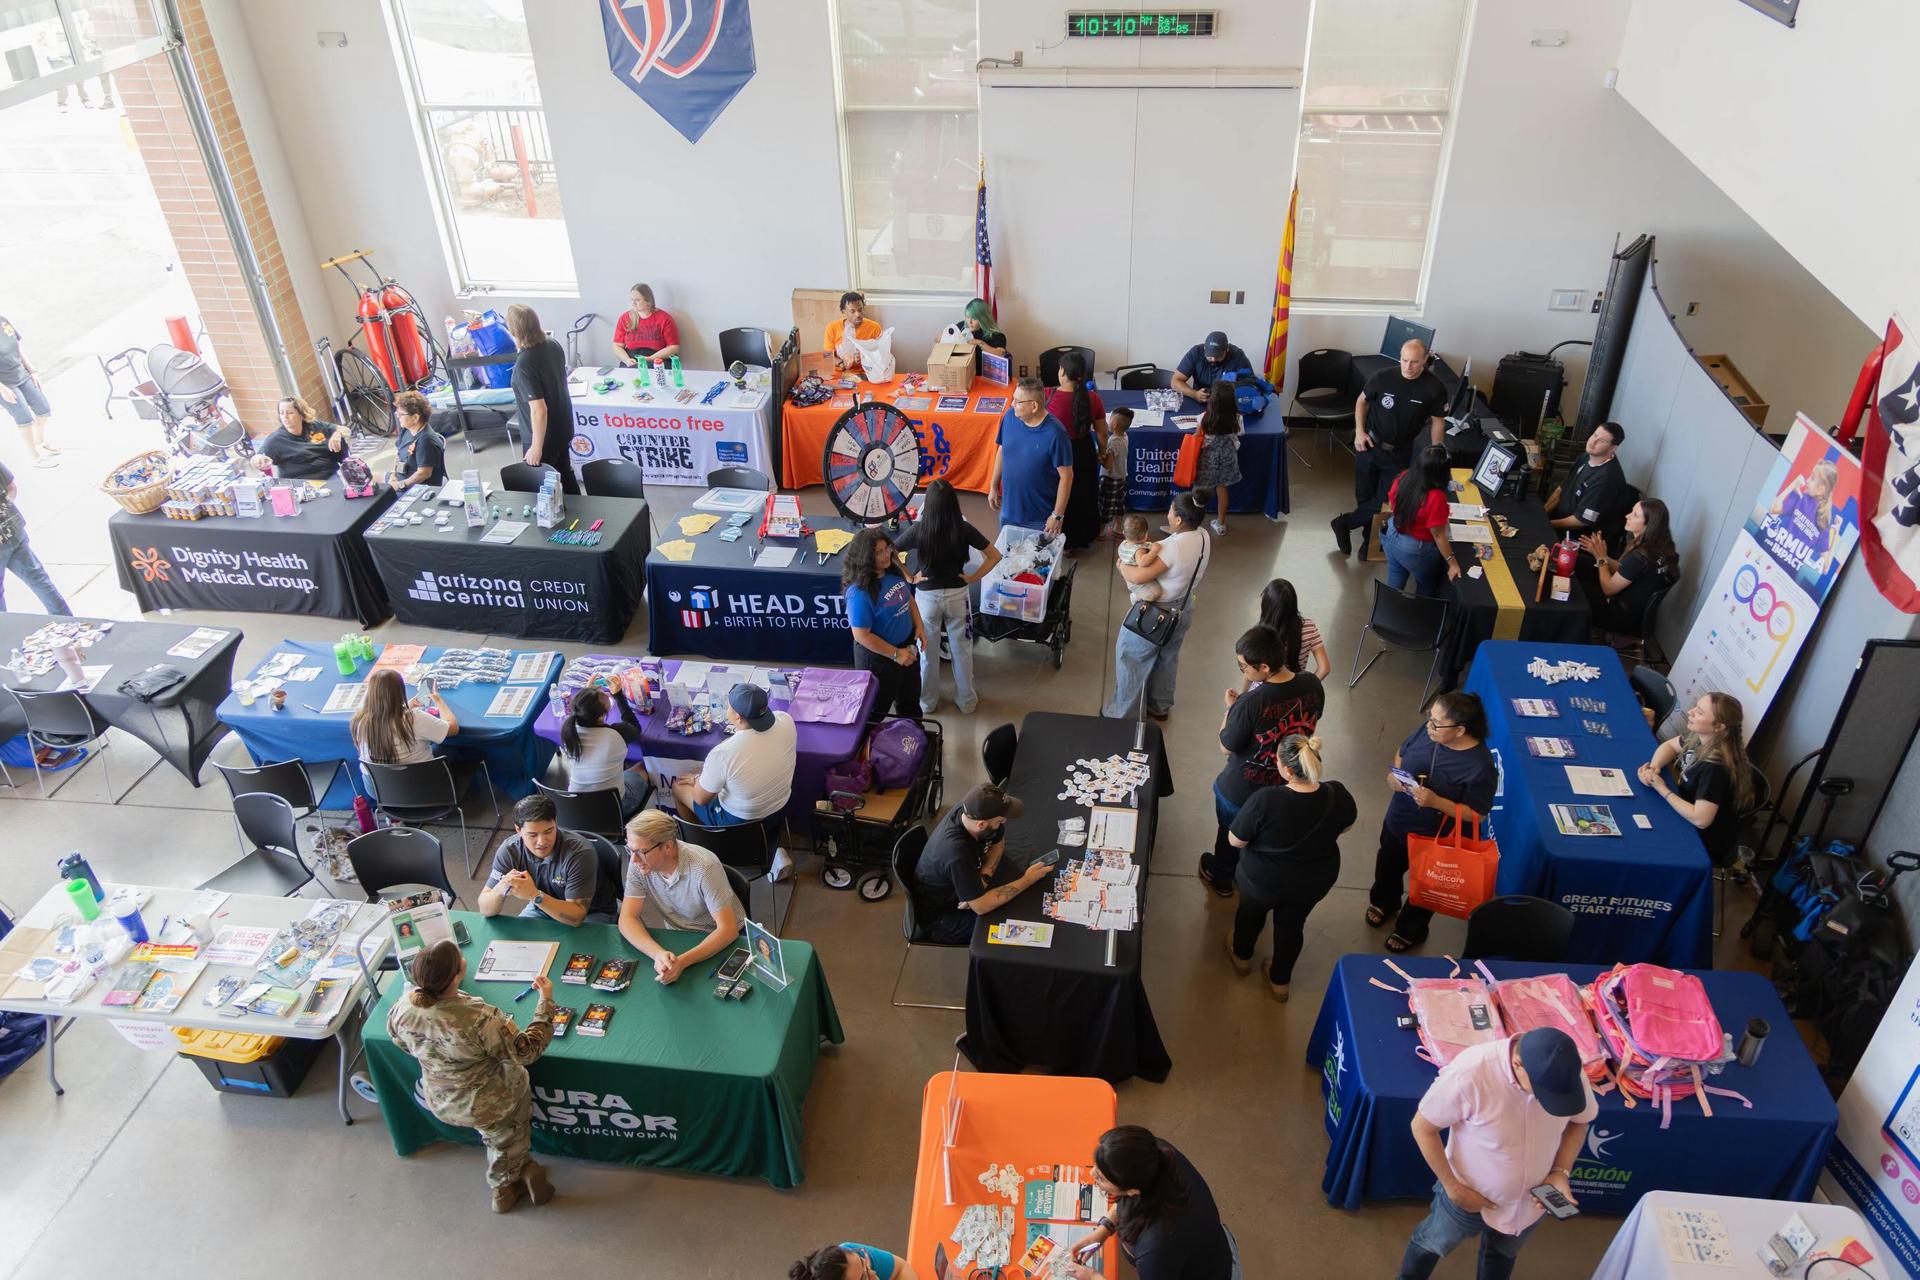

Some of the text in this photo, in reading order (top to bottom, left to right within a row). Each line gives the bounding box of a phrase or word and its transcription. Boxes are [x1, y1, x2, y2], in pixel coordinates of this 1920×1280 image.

[1076, 18, 1136, 34] 10:10
[1140, 16, 1153, 26] AM
[576, 411, 725, 432] be tobacco free
[616, 433, 691, 448] COUNTER
[931, 422, 952, 454] &
[618, 445, 694, 469] STRIKE
[1135, 448, 1180, 461] United
[171, 546, 308, 571] Dignity Health
[1771, 543, 1804, 571] IMPACT
[180, 567, 319, 594] Medical Group.
[438, 573, 586, 596] arizona CREDIT
[443, 590, 590, 613] central UNION
[728, 594, 805, 614] HEAD
[723, 616, 851, 629] BIRTH TO FIVE PRO
[1426, 869, 1465, 884] Medicare
[1562, 894, 1673, 912] GREAT FUTURES
[1570, 904, 1656, 919] START HERE.
[234, 929, 270, 940] BLOCK
[532, 1086, 632, 1111] URA
[564, 1127, 677, 1141] COUNCILWOMAN
[1034, 1188, 1044, 1214] Project
[1043, 1184, 1053, 1215] REWIND
